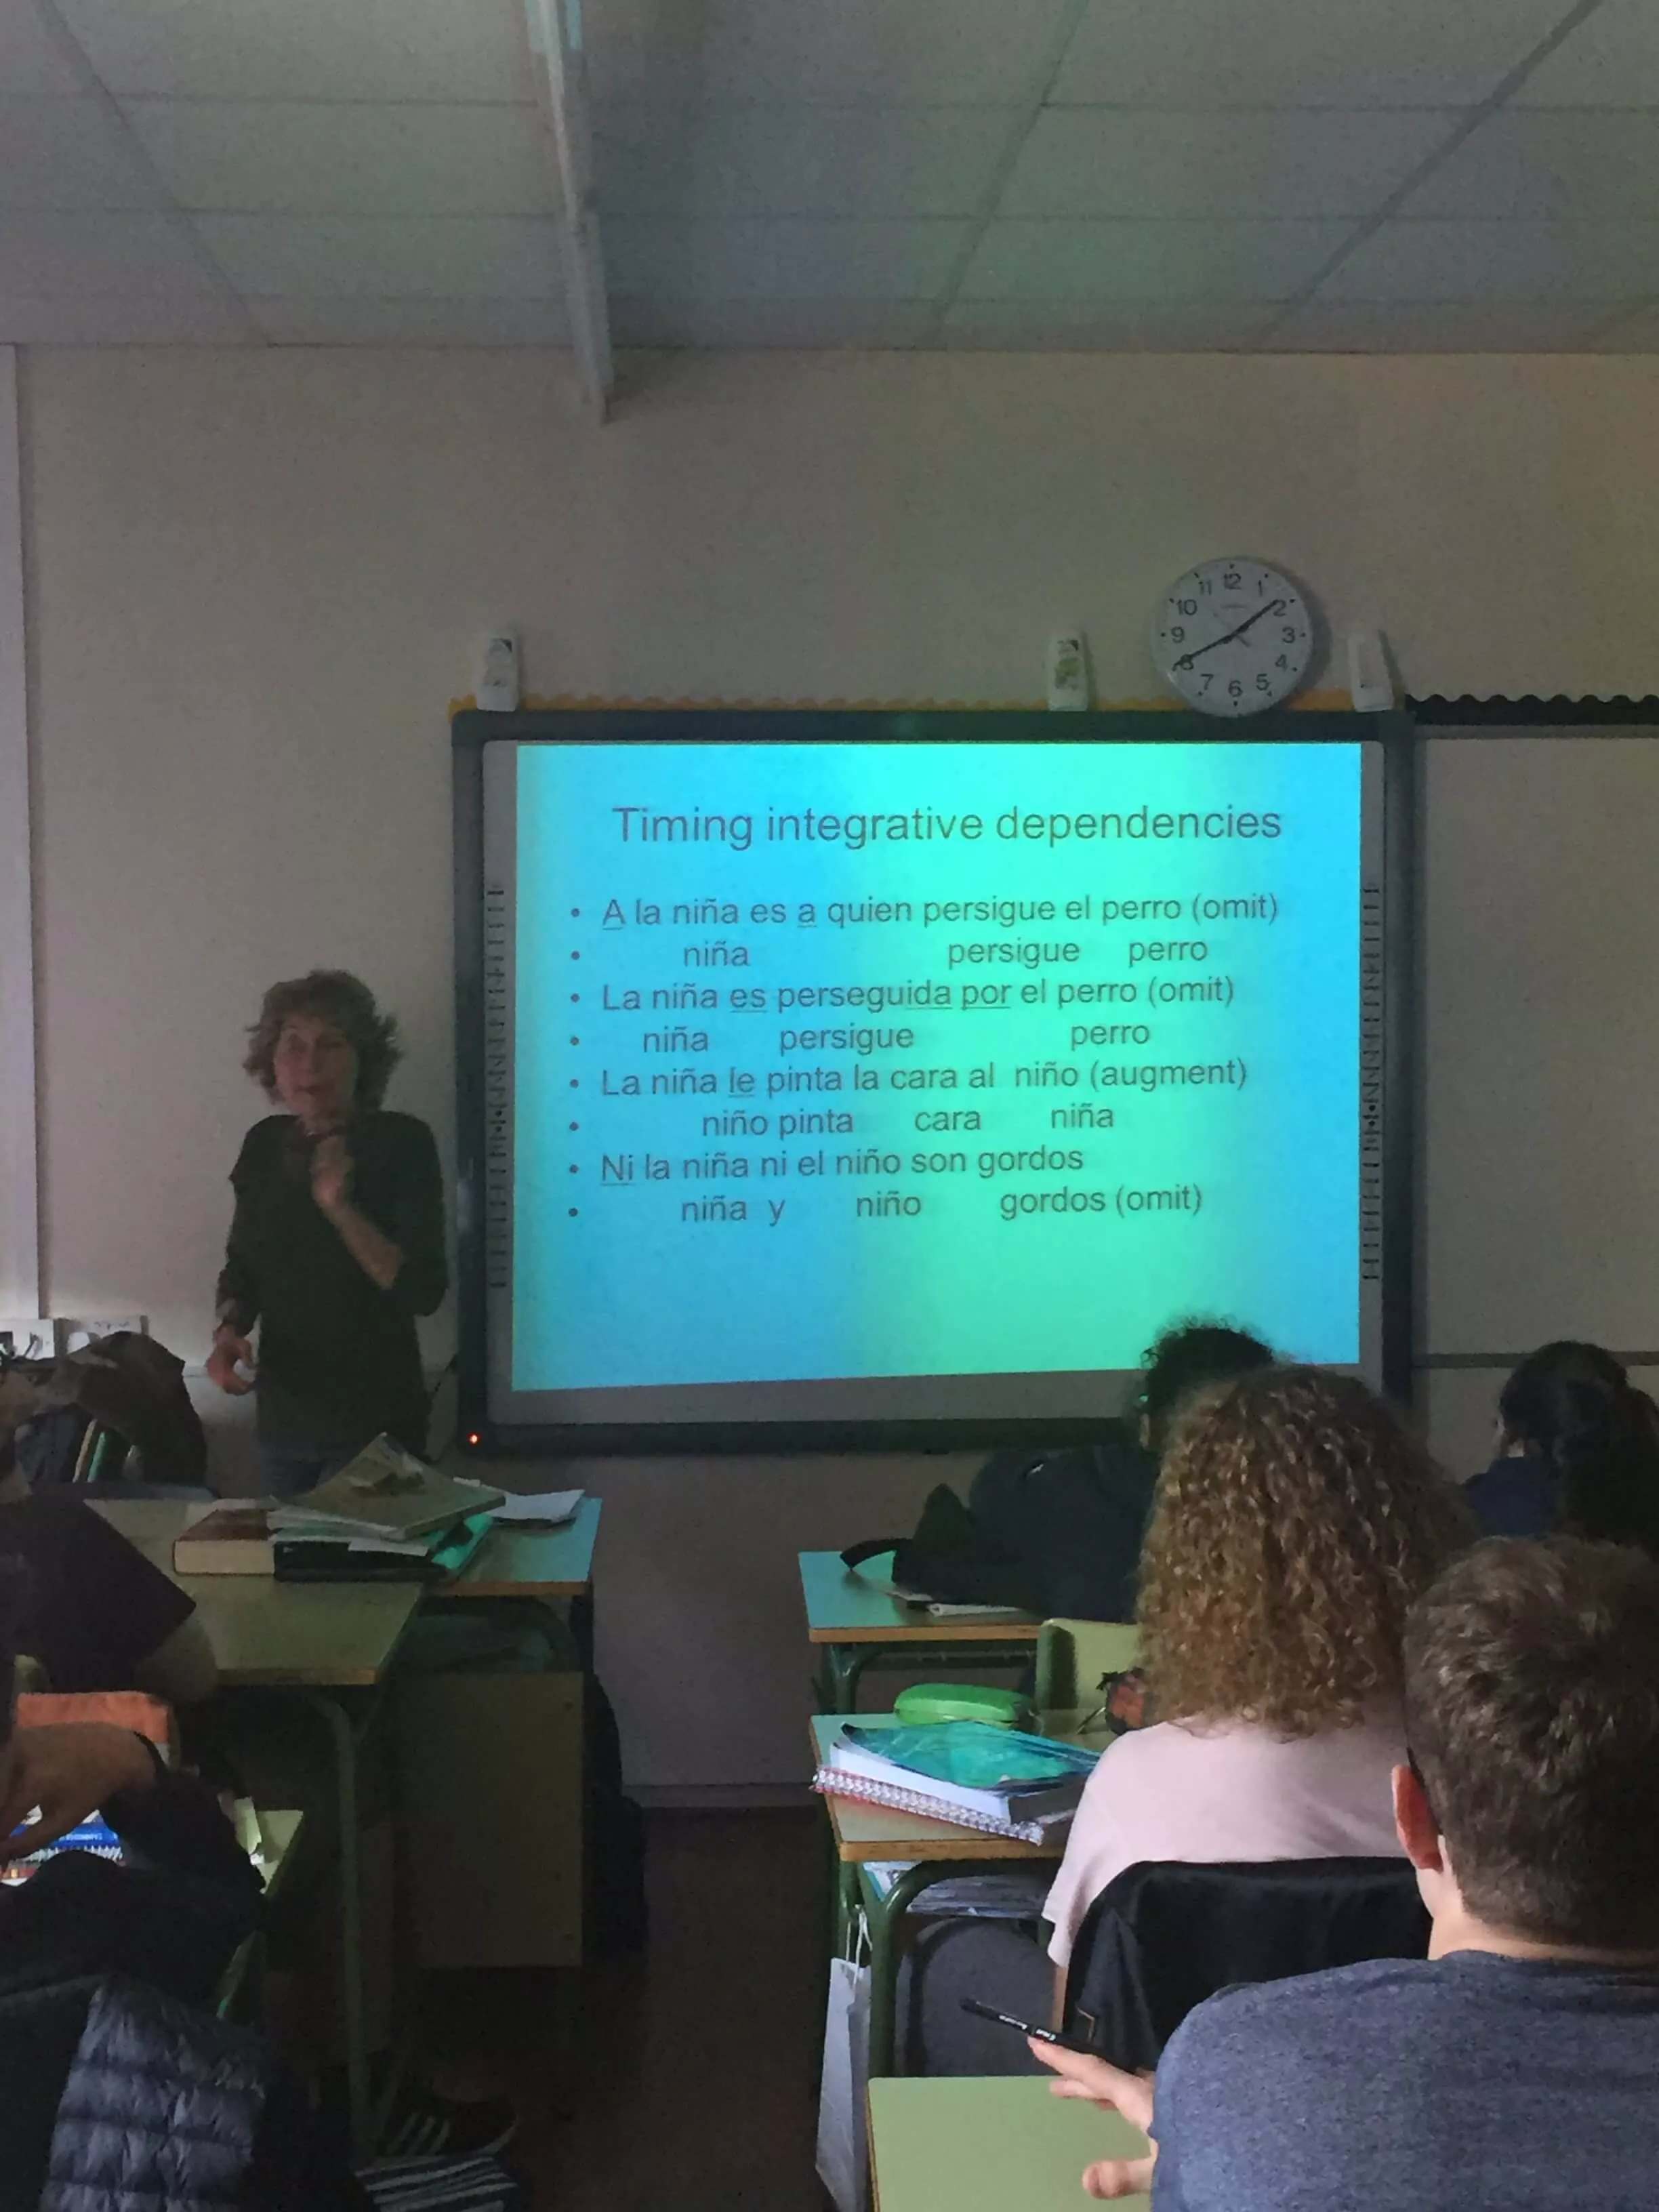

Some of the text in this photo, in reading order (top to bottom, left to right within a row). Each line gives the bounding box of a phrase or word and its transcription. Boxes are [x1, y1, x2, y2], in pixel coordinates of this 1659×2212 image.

[1199, 581, 1212, 595] 11
[1224, 573, 1242, 590] 12
[1258, 580, 1262, 596] 1
[1176, 599, 1197, 615] 10
[1273, 600, 1286, 617] 2
[1171, 626, 1185, 643] 9
[1282, 627, 1295, 644] 3
[1275, 655, 1288, 670] 4
[1201, 674, 1214, 690] 7
[1228, 680, 1242, 697] 6
[1256, 674, 1271, 691] 5
[612, 804, 1282, 852] Timing integrative dependencies
[602, 892, 1279, 929] A la niña es a quien persigue el perro (omit)
[684, 937, 1208, 970] niña persigue perro
[603, 975, 1234, 1014] La niña es perseguida por el perro (omit)
[643, 1023, 1150, 1057] niña persigue perro
[602, 1057, 1246, 1099] La niña le pinta la cara al niño (augment)
[702, 1102, 1114, 1141] niño pinta cara niña
[602, 1146, 1083, 1182] Ni la niña ni el niño son gordos
[681, 1184, 1203, 1227] niña y niño gordos (omit)
